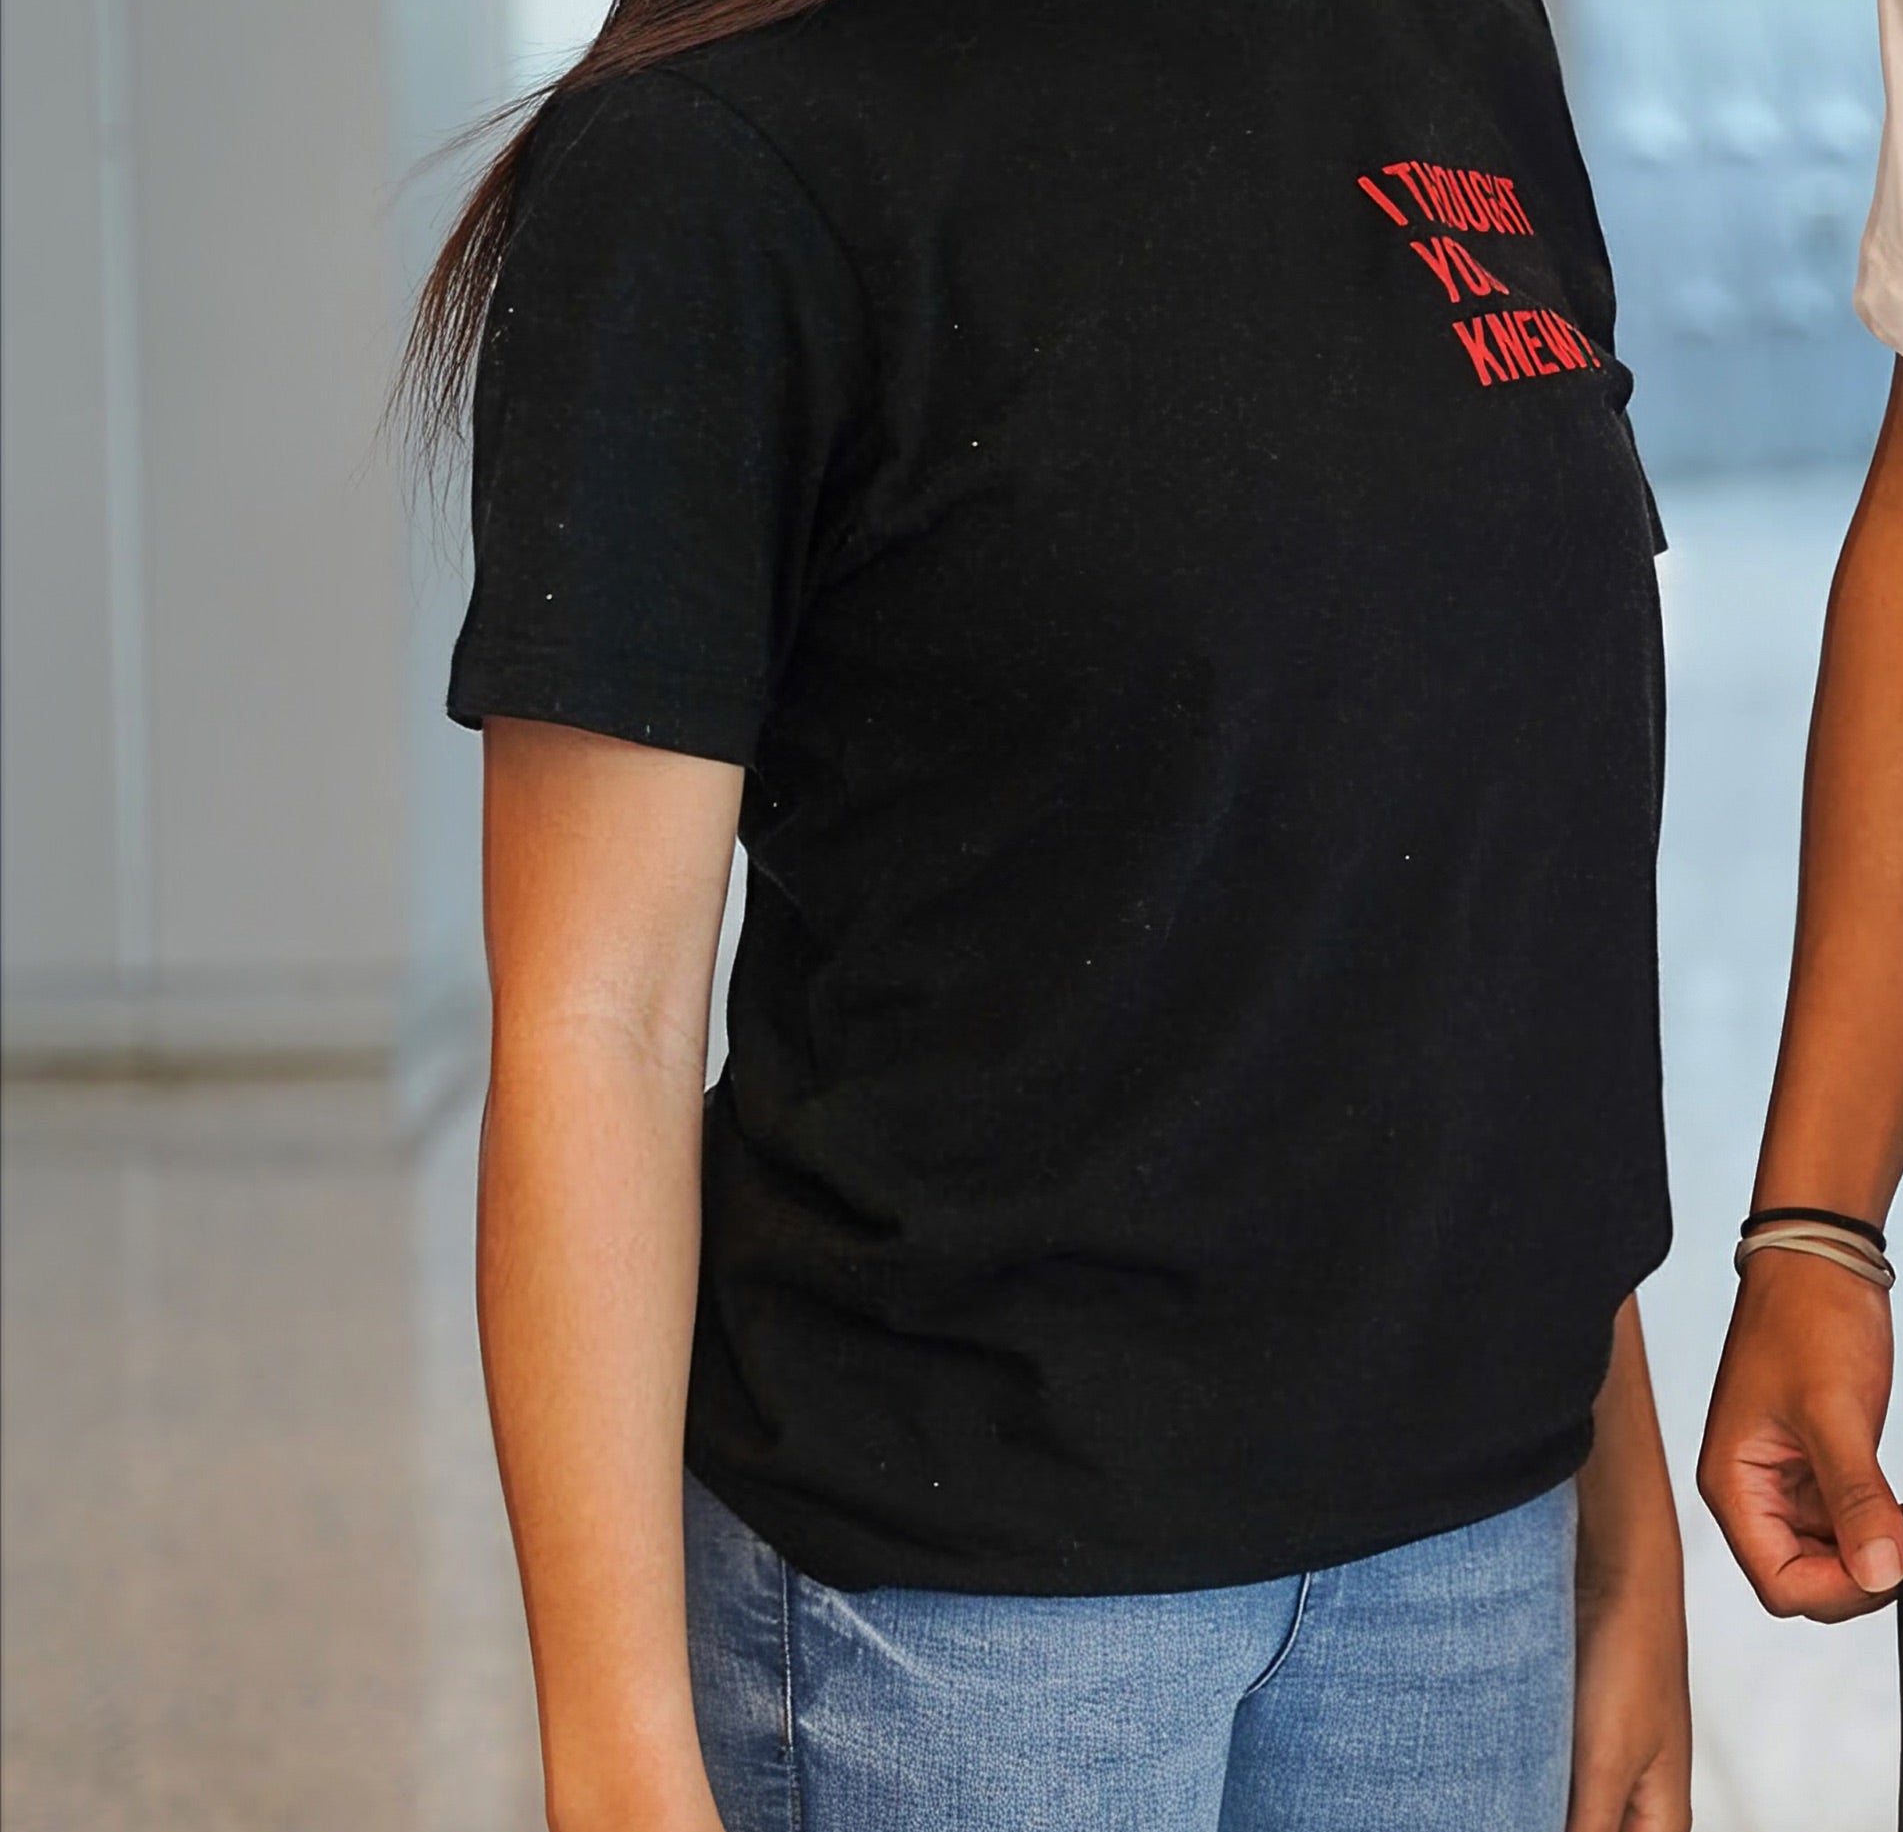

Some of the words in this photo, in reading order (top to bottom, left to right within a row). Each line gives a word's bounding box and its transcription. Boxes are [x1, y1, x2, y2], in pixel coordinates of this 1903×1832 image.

[1357, 176, 1409, 226] I
[1381, 160, 1535, 237] THOUGHT
[1409, 236, 1510, 304] YO
